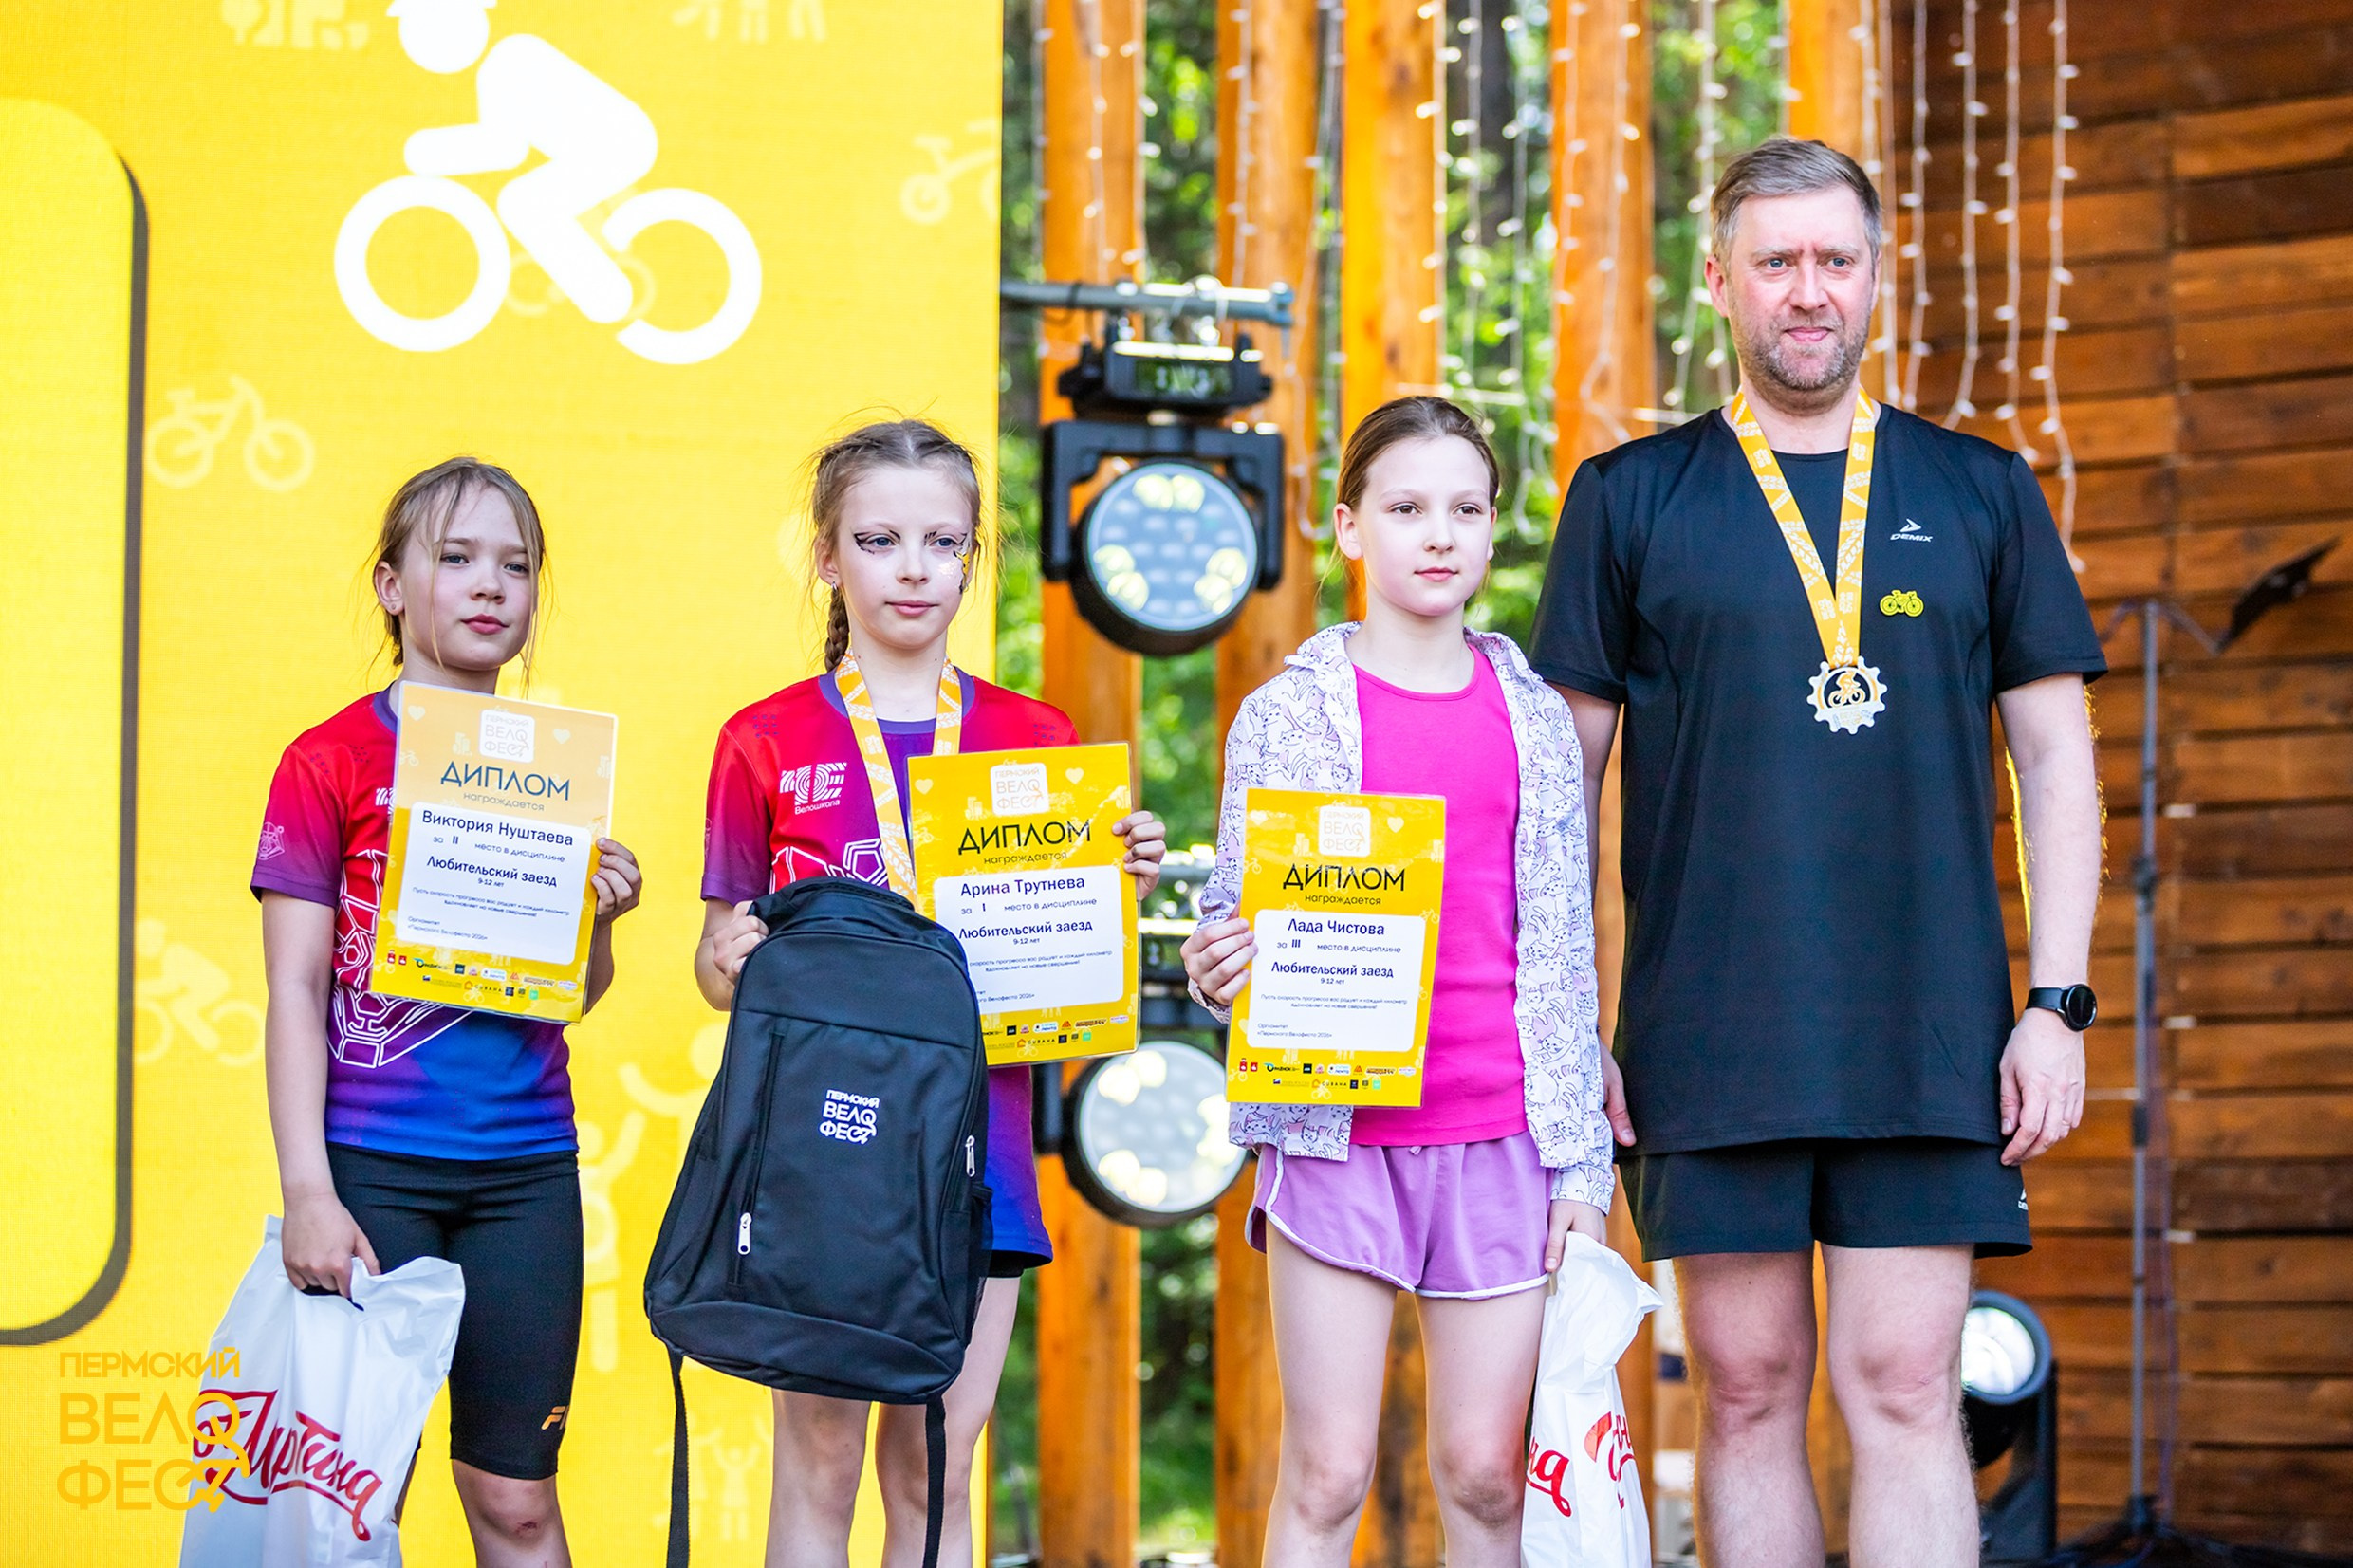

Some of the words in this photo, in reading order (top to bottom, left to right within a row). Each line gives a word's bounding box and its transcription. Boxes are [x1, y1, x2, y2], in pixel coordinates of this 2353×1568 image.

[1890, 533, 1934, 543] DEMIX
[485, 724, 528, 741] ВЕЛО
[440, 760, 570, 801] ДИПЛОМ
[995, 779, 1041, 794] ВЕЛО
[463, 792, 545, 812] награждается
[794, 799, 841, 815] Велошкола
[422, 809, 493, 834] Виктория
[498, 821, 574, 846] Нуштаева
[1324, 821, 1364, 835] ВЕЛО
[958, 819, 1091, 856] ДИПЛОМ
[433, 836, 444, 844] за
[474, 843, 502, 853] место
[510, 849, 565, 863] дисциплине
[984, 851, 1067, 865] награждается
[426, 855, 518, 880] Любительский
[521, 872, 557, 888] заезд
[1283, 862, 1405, 892] ДИПЛОМ
[477, 877, 493, 886] 9-12
[960, 882, 1010, 898] Арина
[1014, 877, 1085, 895] Трутнева
[1004, 903, 1032, 912] место
[1041, 898, 1097, 910] дисциплине
[1305, 895, 1381, 905] награждается
[958, 921, 1052, 939] Любительский
[1056, 921, 1093, 932] заезд
[1288, 918, 1323, 933] Лада
[1327, 919, 1385, 935] Чистова
[1291, 939, 1301, 948] III
[1350, 945, 1401, 953] дисциплине
[1271, 961, 1358, 976] Любительский
[1360, 967, 1394, 978] заезд
[825, 1089, 880, 1109] ПЕРМСКИЙ
[823, 1100, 877, 1126] ВЕЛО
[819, 1120, 877, 1145] ФЕСТ
